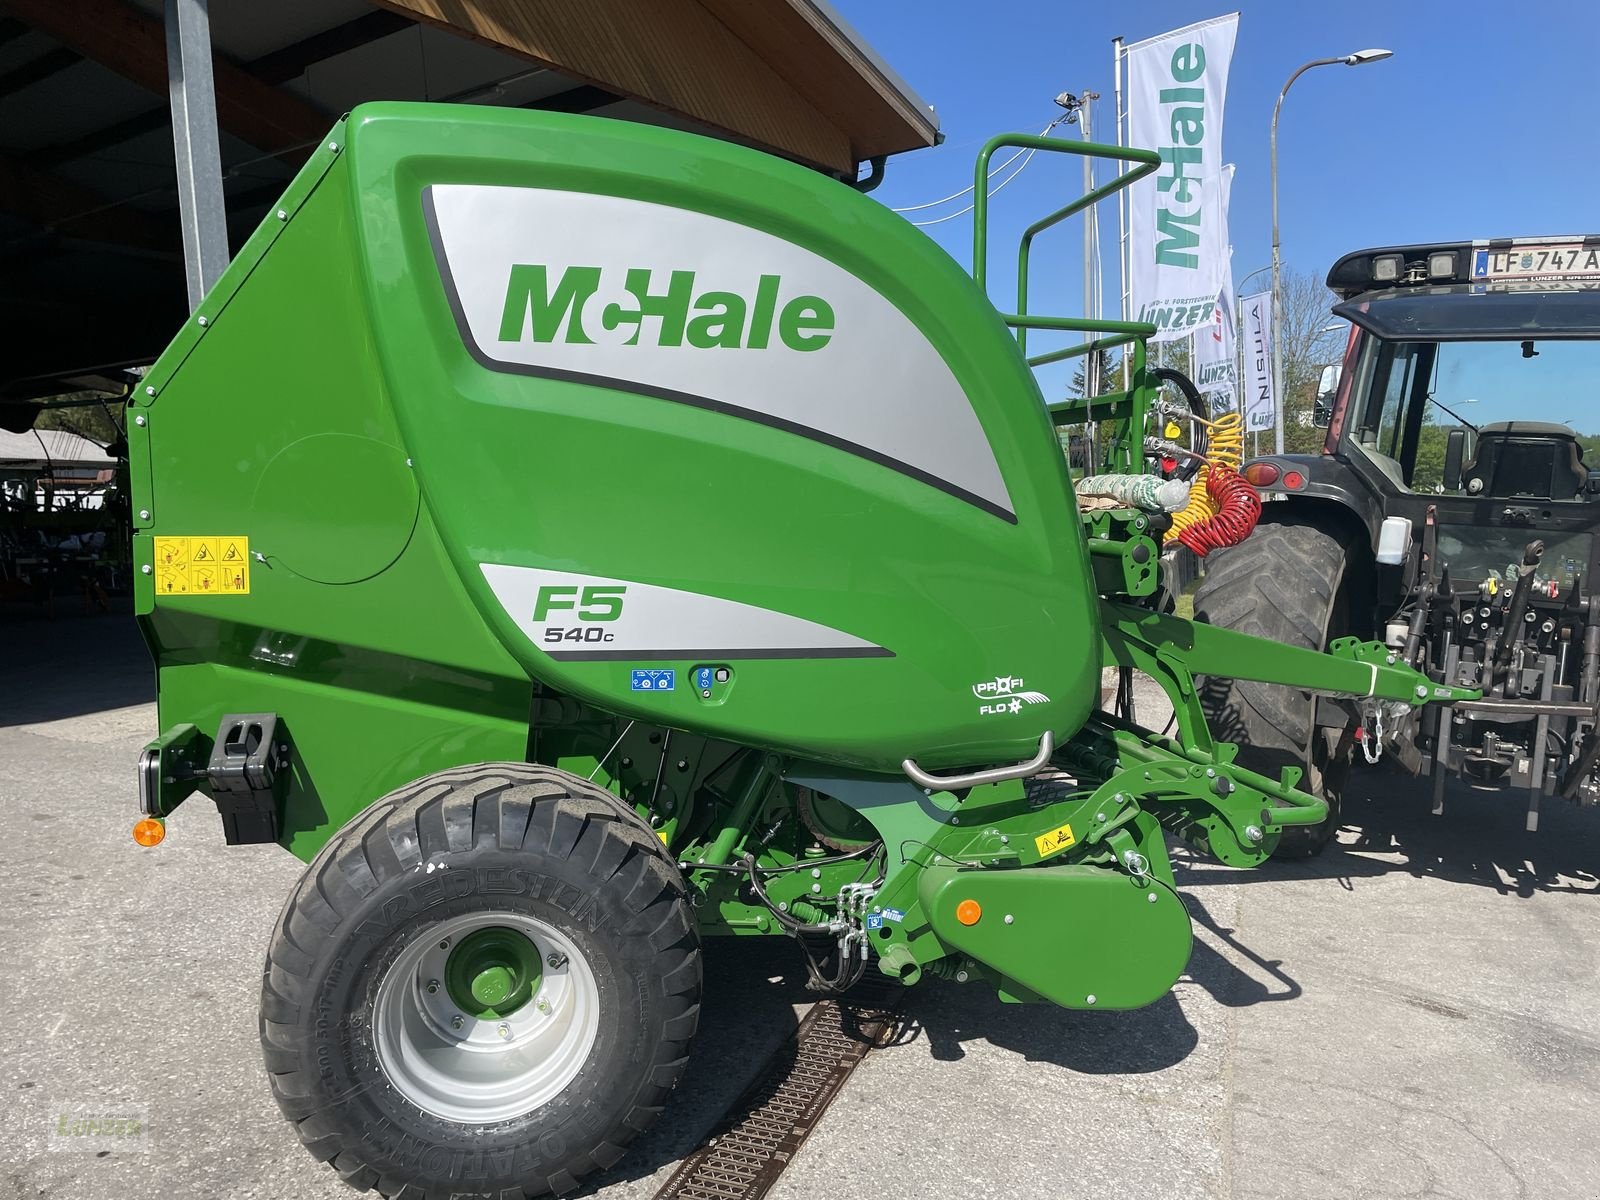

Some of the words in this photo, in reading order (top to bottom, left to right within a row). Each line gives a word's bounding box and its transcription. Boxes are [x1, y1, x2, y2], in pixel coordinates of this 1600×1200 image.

[1155, 43, 1206, 269] McHale
[1493, 253, 1519, 273] LF
[1537, 250, 1579, 271] 747
[497, 263, 836, 352] McHale
[1251, 304, 1270, 401] NISULA
[533, 585, 627, 622] F5
